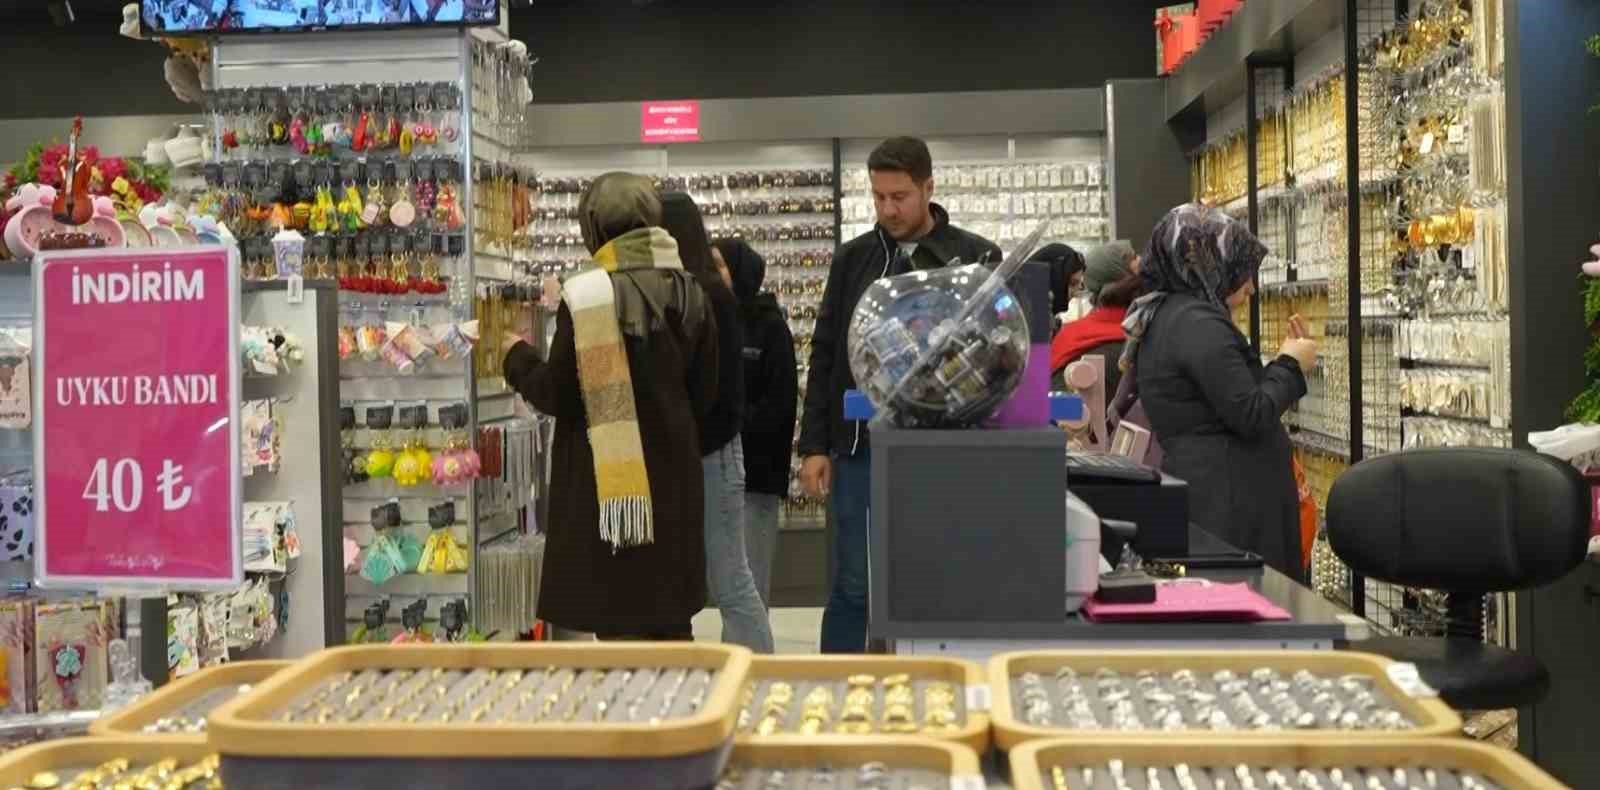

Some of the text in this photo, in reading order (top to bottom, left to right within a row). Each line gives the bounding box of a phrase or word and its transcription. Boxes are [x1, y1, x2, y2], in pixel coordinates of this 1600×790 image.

[72, 262, 204, 304] İNDİRİM
[57, 374, 217, 406] UYKU BANDI
[82, 457, 143, 512] 40
